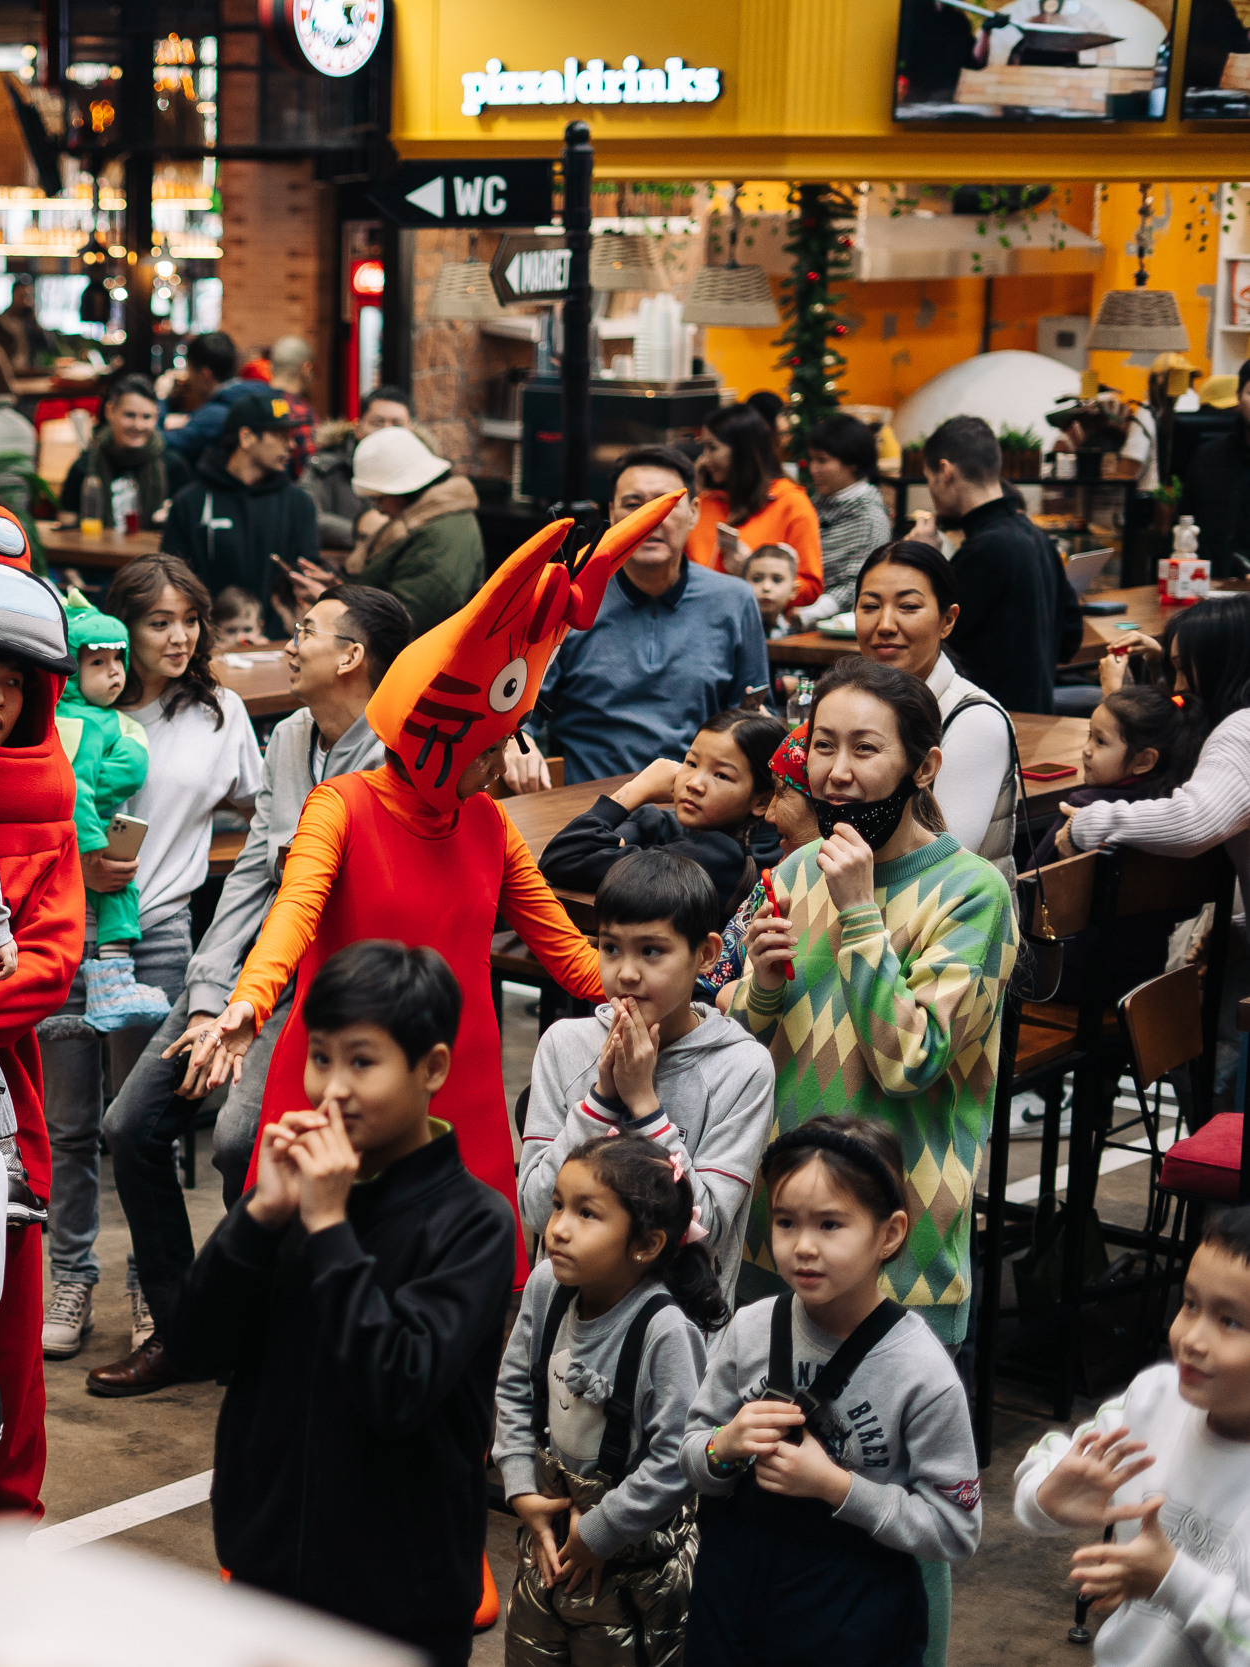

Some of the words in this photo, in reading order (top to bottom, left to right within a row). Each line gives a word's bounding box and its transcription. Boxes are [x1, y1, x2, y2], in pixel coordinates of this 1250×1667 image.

[453, 175, 508, 216] WC
[521, 249, 573, 293] MARKET
[846, 1400, 890, 1468] BIKER
